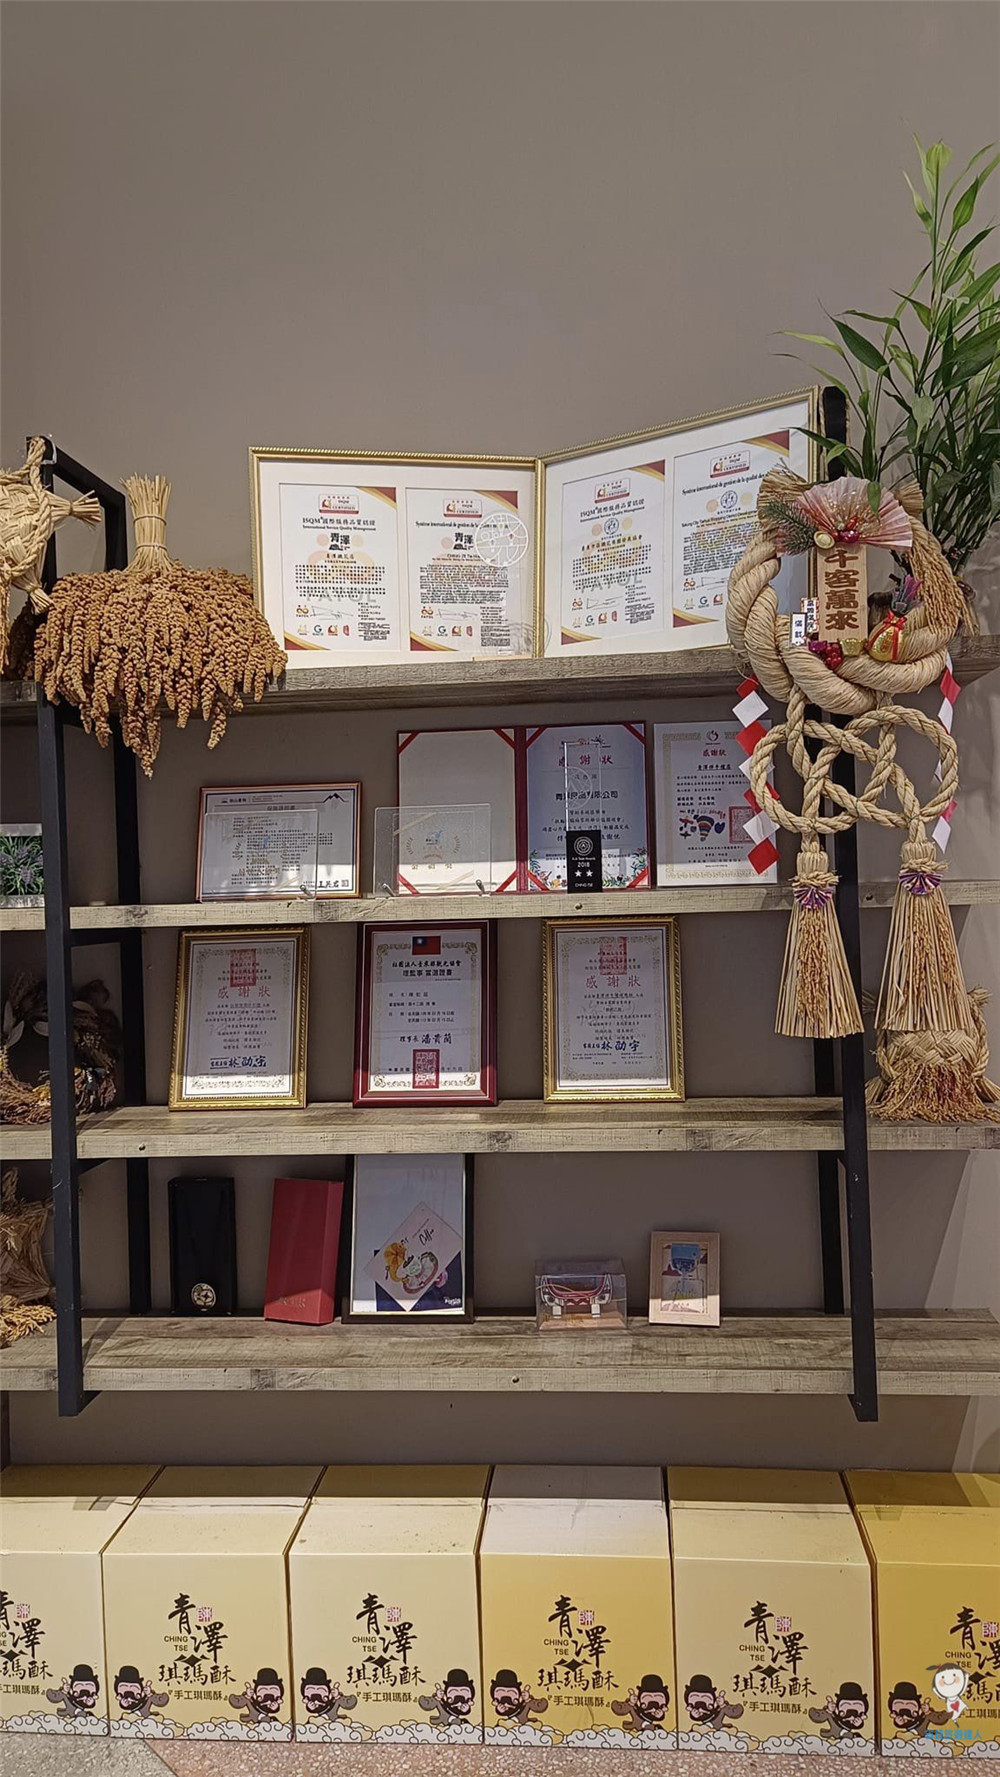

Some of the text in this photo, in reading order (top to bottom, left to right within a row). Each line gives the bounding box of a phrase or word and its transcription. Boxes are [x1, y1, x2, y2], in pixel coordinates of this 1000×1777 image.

[824, 548, 860, 632] 千客萬來
[217, 985, 271, 999] 感謝狀
[586, 975, 641, 989] 感謝狀
[163, 1635, 188, 1643] CHING
[168, 1592, 228, 1664] 青澤
[356, 1592, 418, 1665] 青澤
[548, 1594, 611, 1669] 青澤
[743, 1600, 809, 1676] 青澤
[543, 1638, 569, 1646] CHING
[739, 1644, 765, 1652] CHING
[945, 1651, 972, 1659] CHING
[0, 1659, 53, 1680] 瑪酥
[158, 1662, 236, 1686] 琪瑪酥
[346, 1663, 426, 1688] 琪瑪酥
[537, 1666, 619, 1692] 琪瑪酥
[733, 1672, 817, 1698] 琪瑪酥
